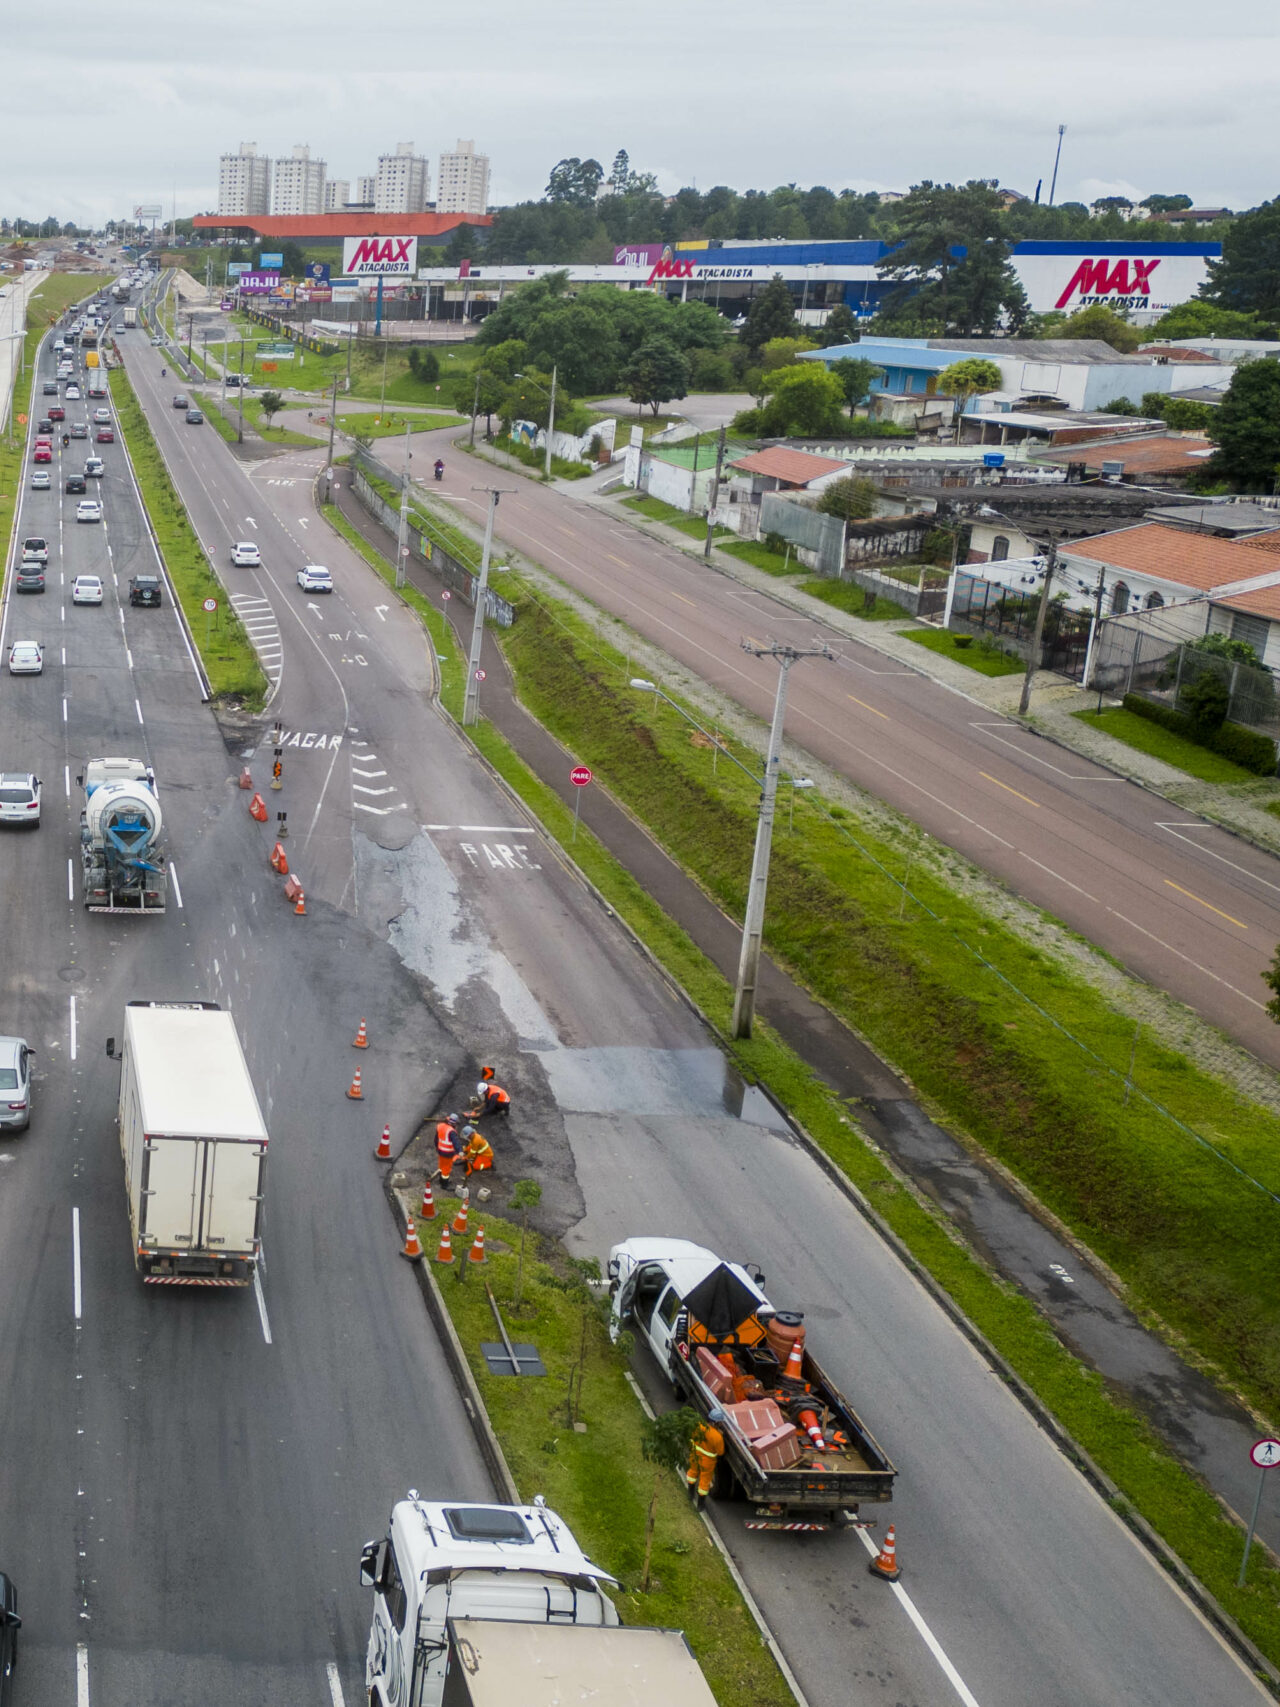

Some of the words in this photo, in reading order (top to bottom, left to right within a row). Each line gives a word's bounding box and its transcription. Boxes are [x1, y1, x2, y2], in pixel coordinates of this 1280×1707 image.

[347, 239, 414, 272] MAX
[358, 263, 409, 272] ATACADISTA
[646, 259, 697, 286] MAX
[697, 269, 753, 278] ATACADISTA
[1055, 259, 1161, 308] MAX
